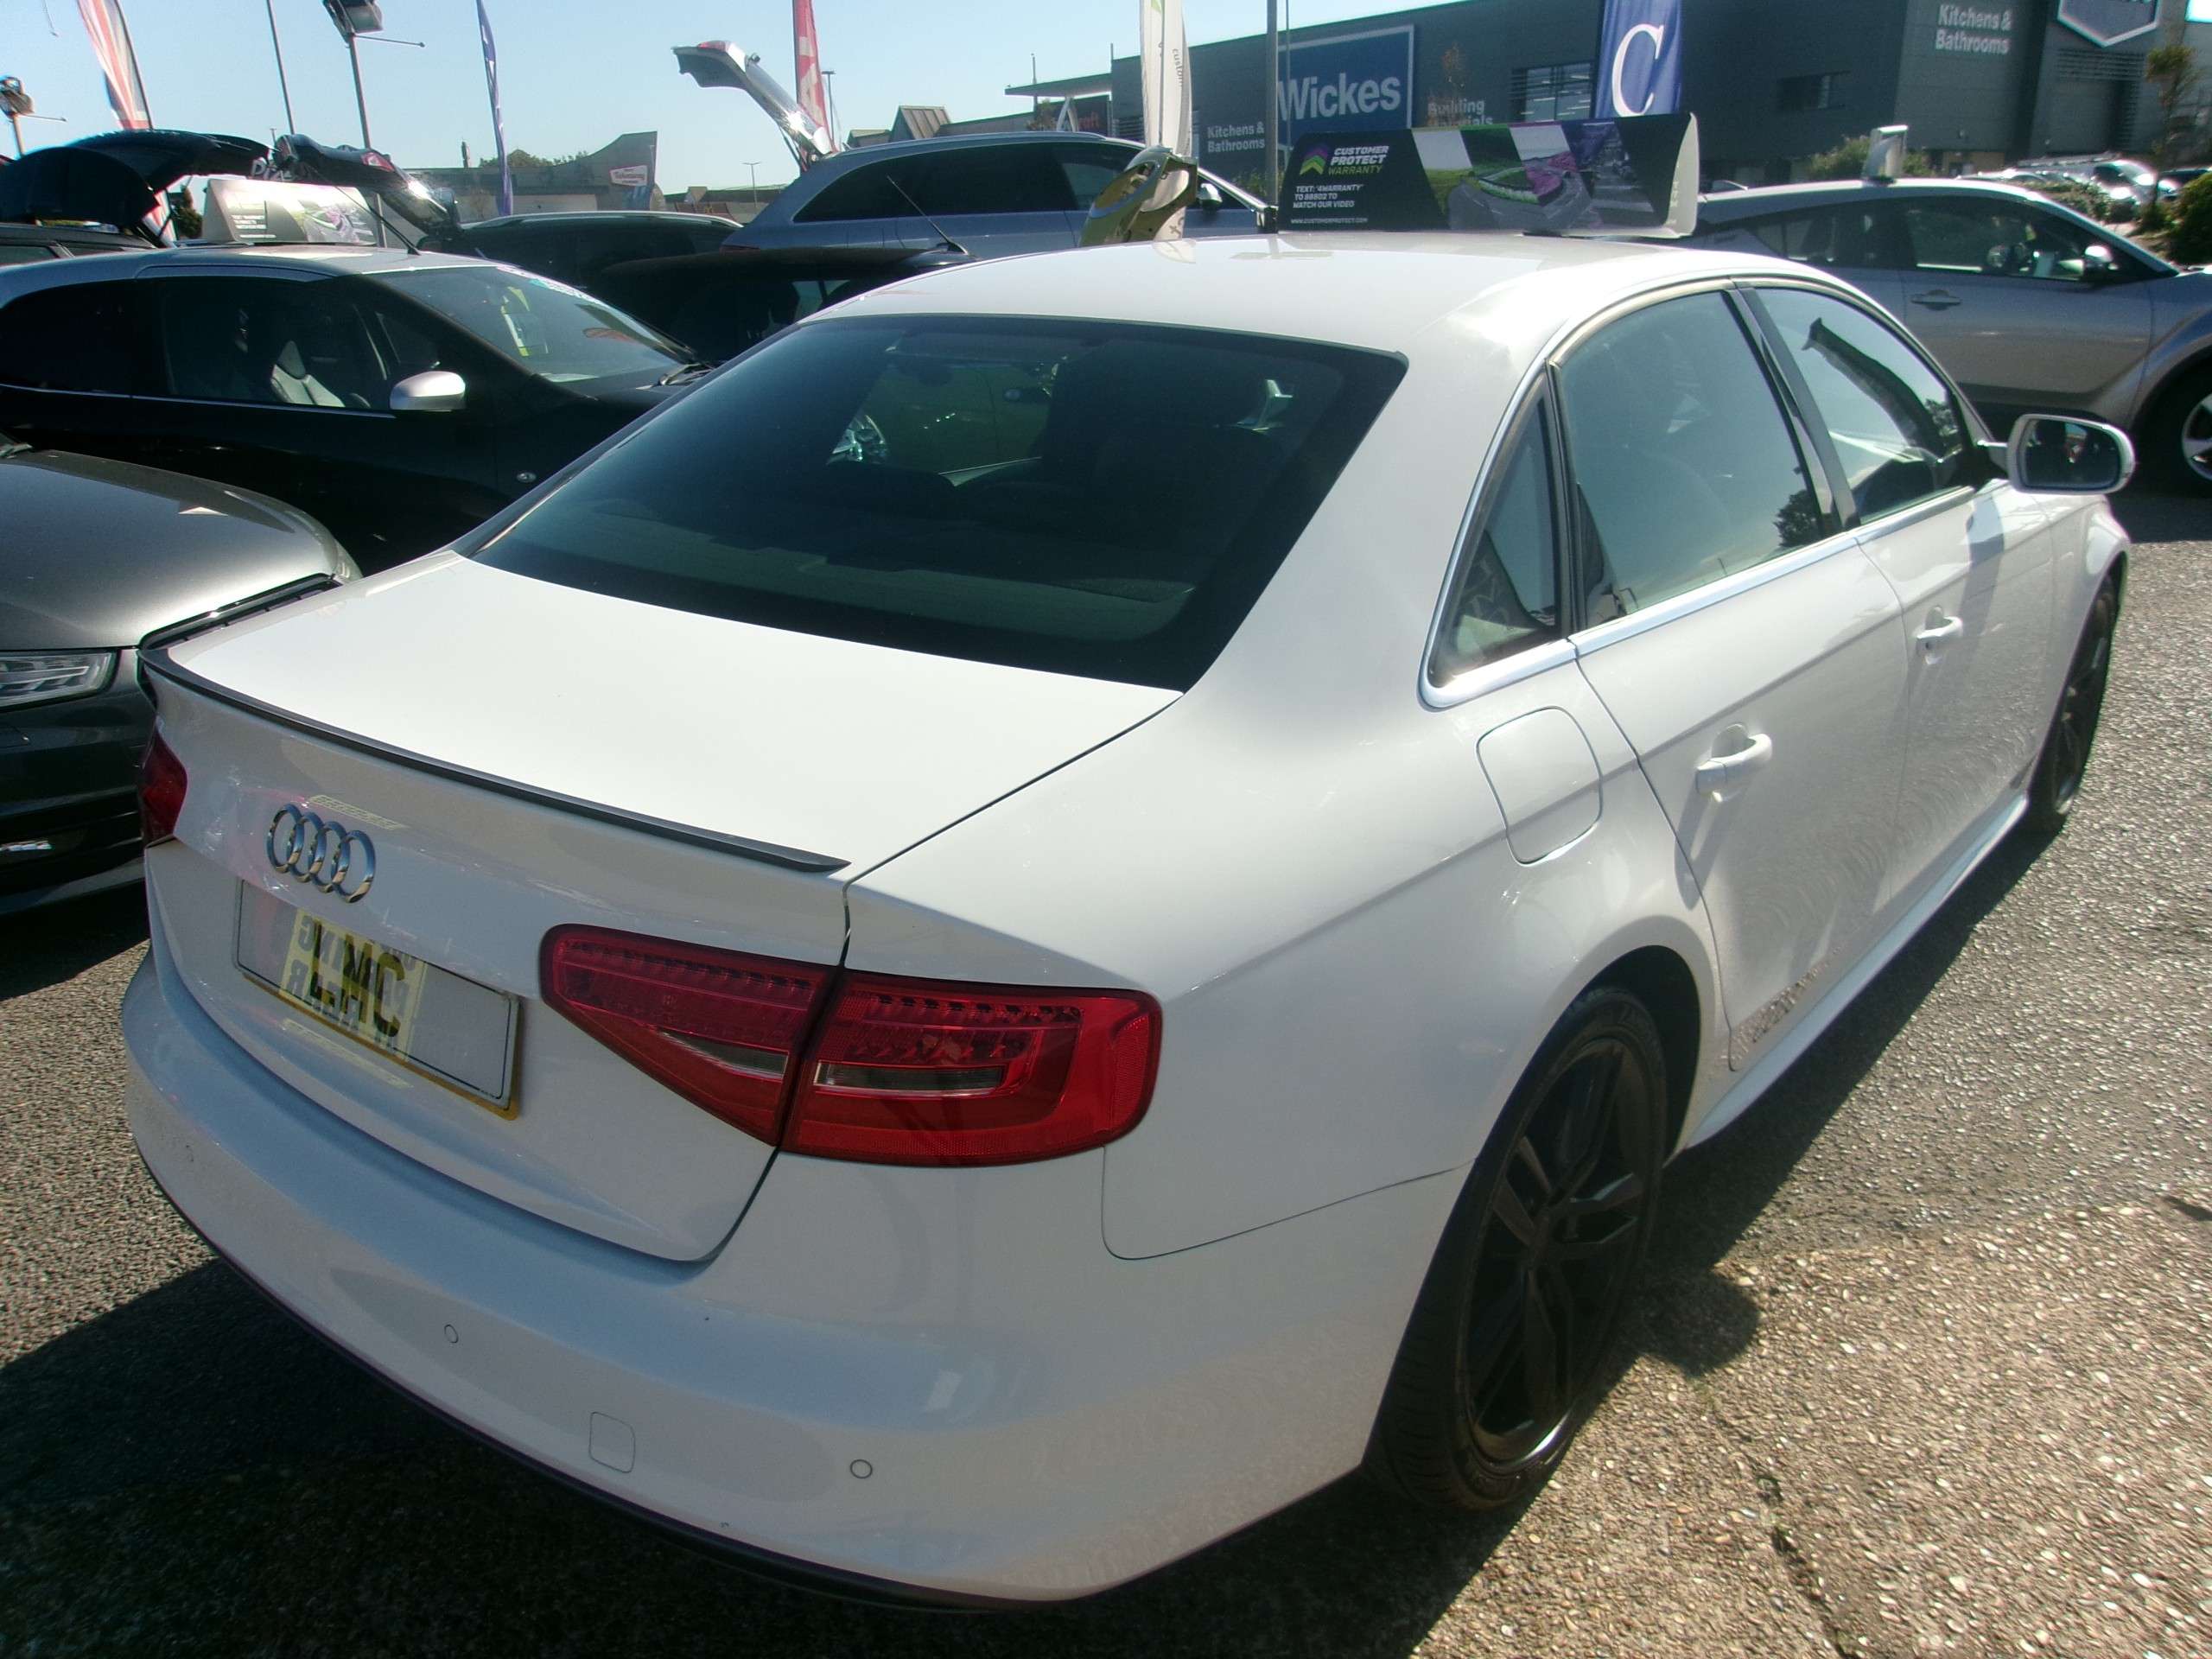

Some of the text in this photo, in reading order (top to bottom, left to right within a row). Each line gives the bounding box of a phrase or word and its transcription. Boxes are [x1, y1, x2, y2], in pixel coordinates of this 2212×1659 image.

[1938, 4, 2012, 31] Kitchens &
[1936, 29, 2010, 54] Bathrooms
[1277, 73, 1402, 122] Wickes
[1207, 121, 1265, 138] Kitchens &
[1207, 137, 1265, 153] Bathrooms
[1333, 145, 1389, 156] CUSTOMER
[1330, 155, 1387, 165] PROTECT
[1328, 165, 1382, 175] WARRANTY
